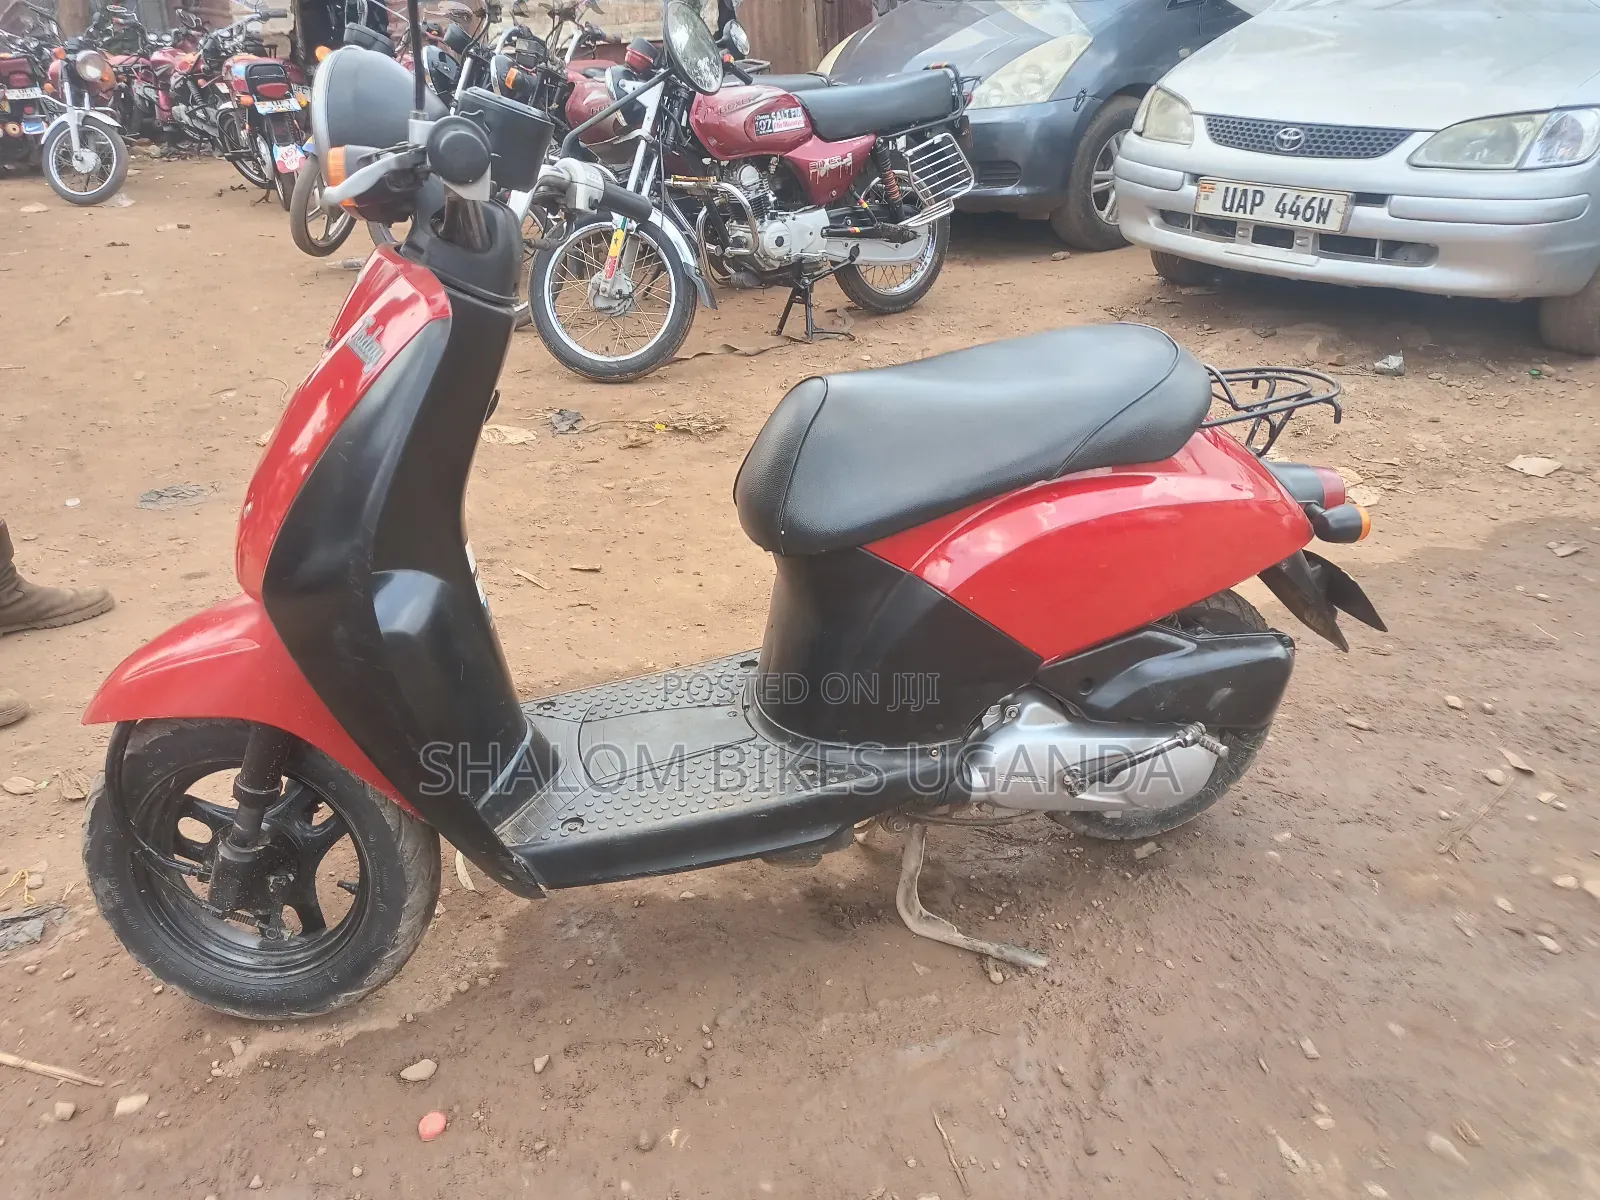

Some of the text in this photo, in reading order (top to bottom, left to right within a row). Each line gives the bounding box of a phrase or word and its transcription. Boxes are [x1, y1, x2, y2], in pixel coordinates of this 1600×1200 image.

[719, 95, 756, 114] BOXER
[1222, 186, 1333, 224] UAP 446W
